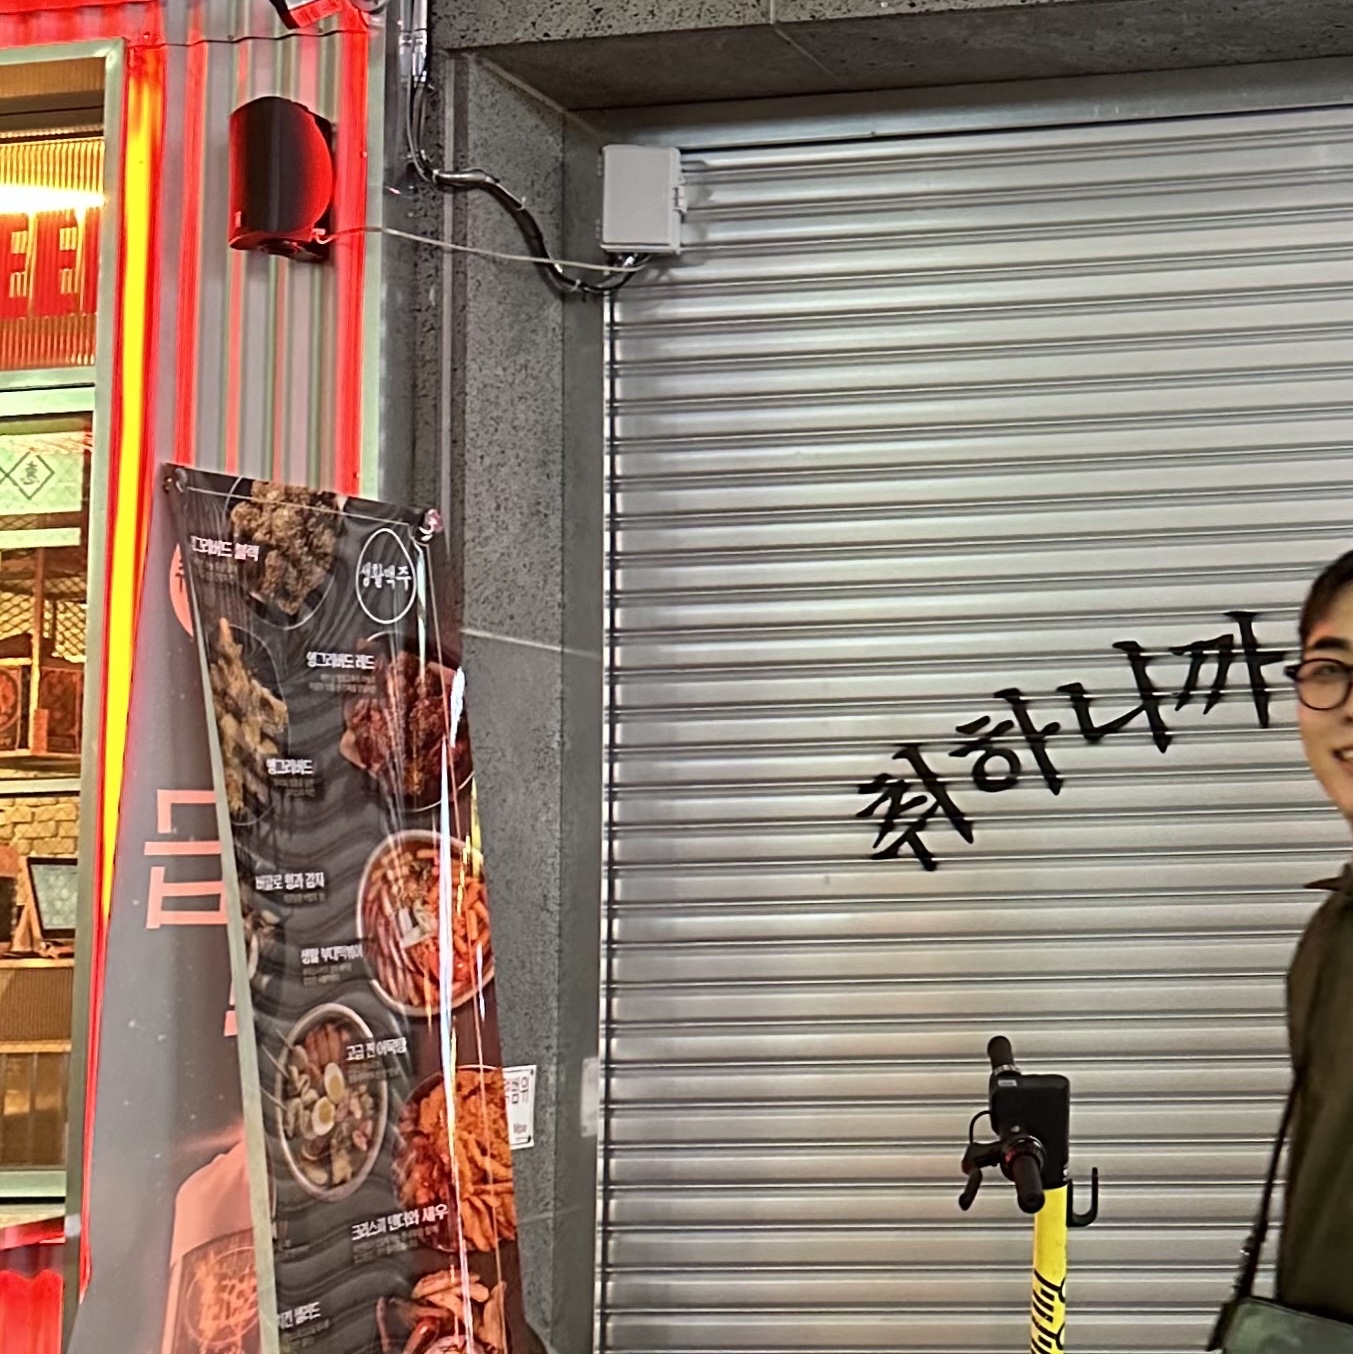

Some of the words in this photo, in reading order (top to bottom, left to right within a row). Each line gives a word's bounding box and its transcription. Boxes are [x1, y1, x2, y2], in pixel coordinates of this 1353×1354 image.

[190, 535, 232, 558] 그리버드
[360, 562, 412, 591] 생활맥주
[855, 611, 1287, 872] 취하니까
[421, 1203, 449, 1224] 새우
